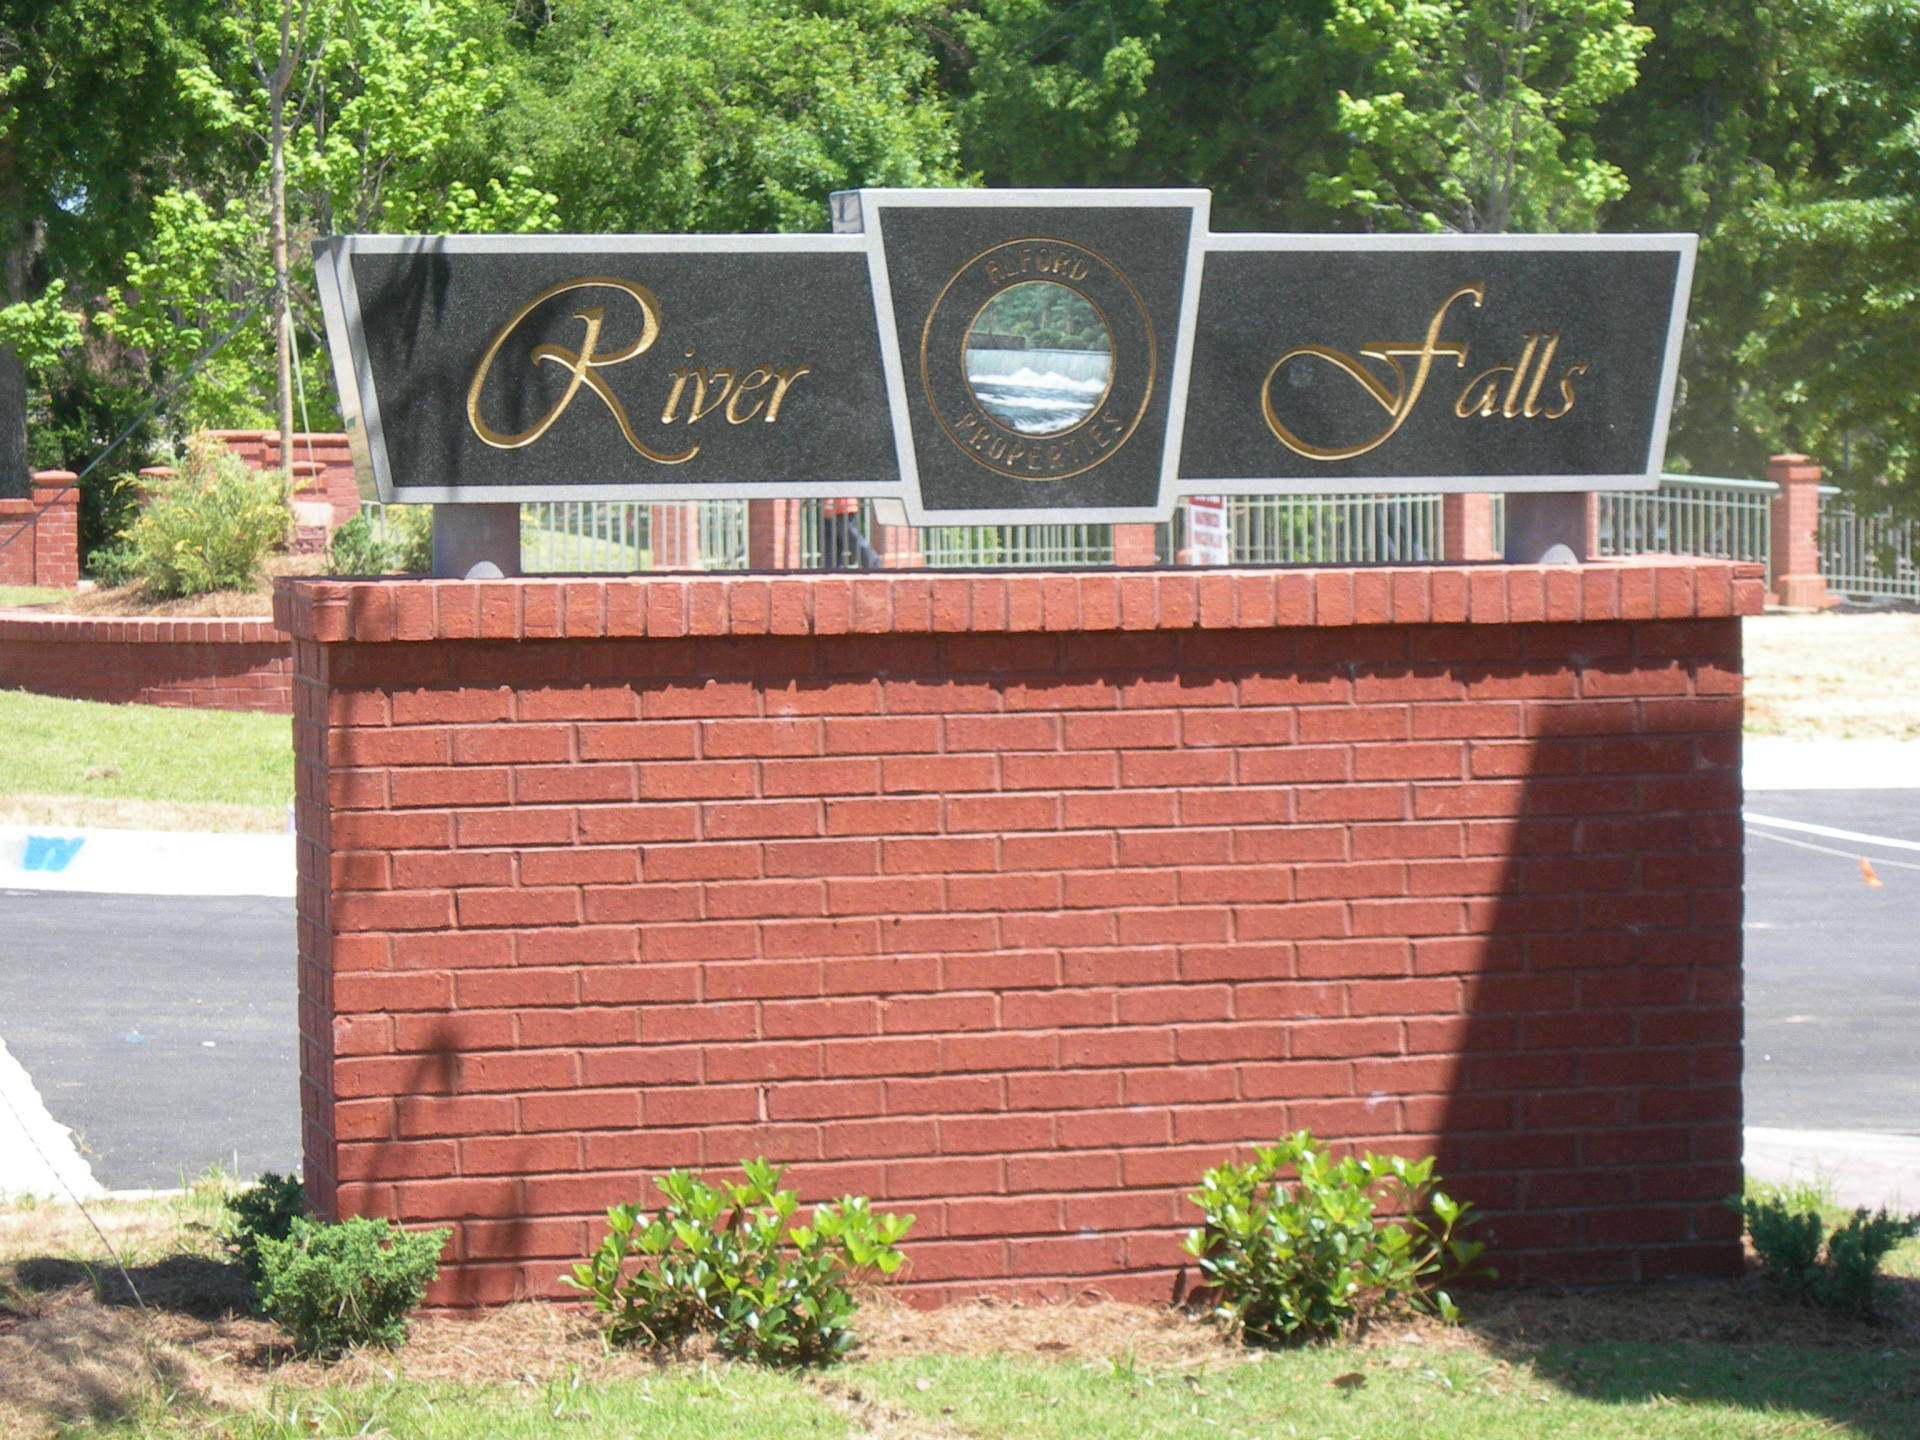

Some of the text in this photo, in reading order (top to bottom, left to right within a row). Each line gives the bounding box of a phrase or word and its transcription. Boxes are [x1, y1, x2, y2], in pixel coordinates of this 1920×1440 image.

[985, 247, 1088, 284] ALFORD
[466, 276, 1588, 464] River Falls
[955, 410, 1123, 470] PROPERTIES
